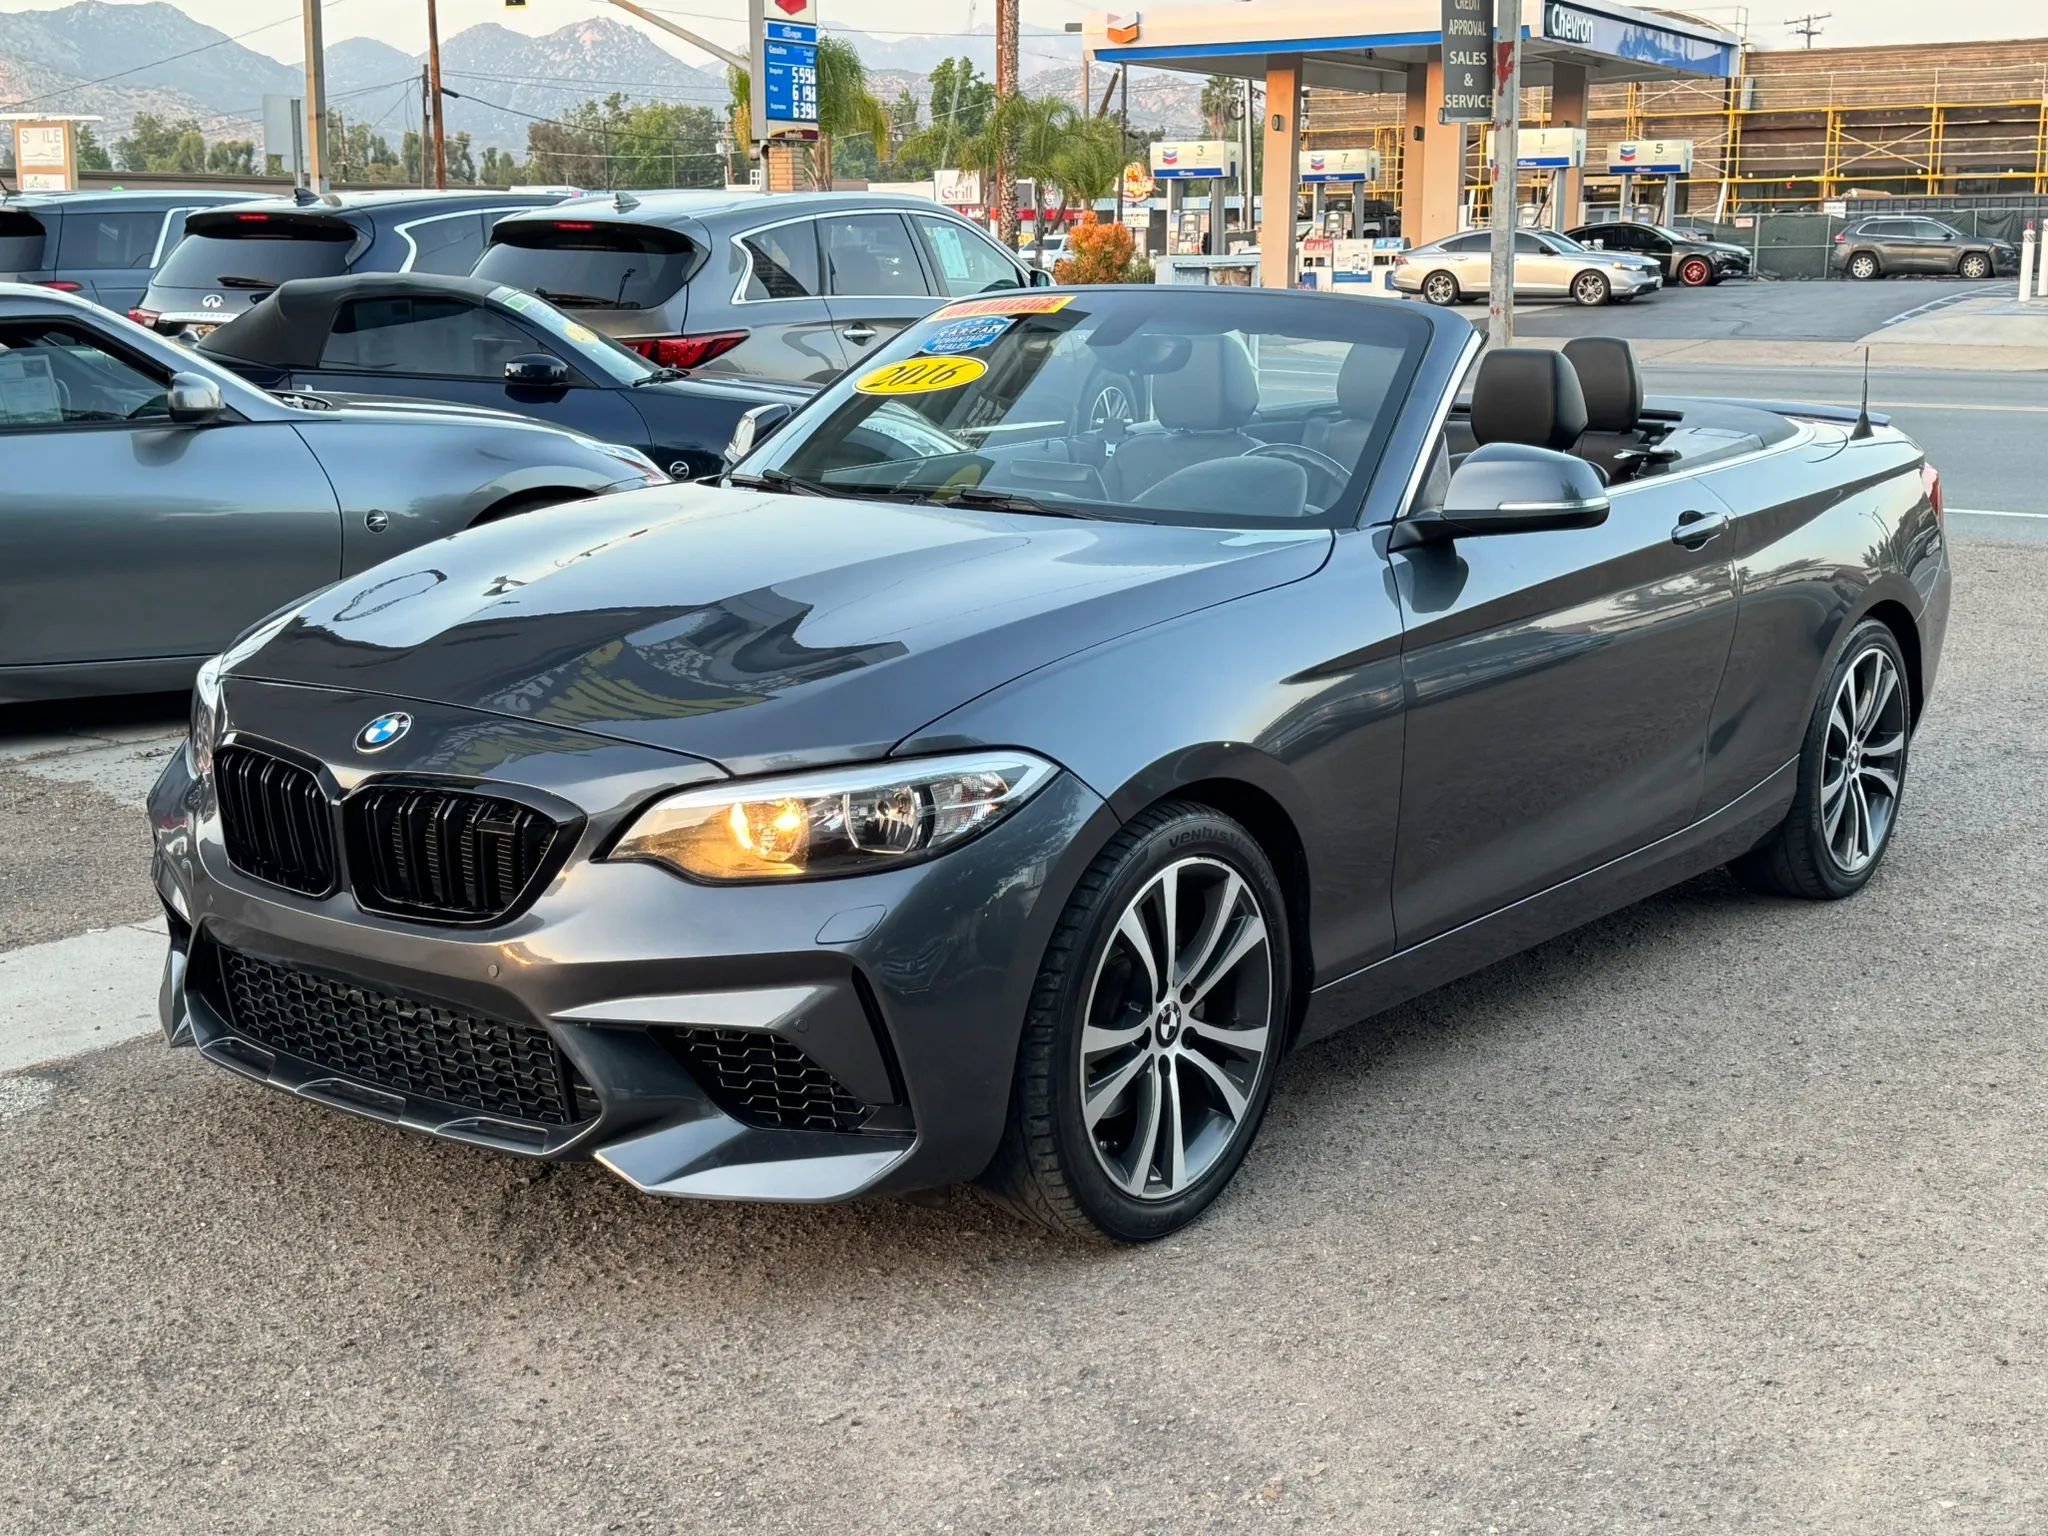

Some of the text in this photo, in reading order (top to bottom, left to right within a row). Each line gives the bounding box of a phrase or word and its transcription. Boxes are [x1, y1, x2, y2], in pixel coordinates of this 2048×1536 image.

[1449, 19, 1487, 36] APPROVAL
[1551, 4, 1594, 43] Chevron
[1450, 51, 1487, 66] SALES
[1464, 73, 1474, 87] &
[1445, 95, 1492, 109] SERVICE
[1196, 145, 1205, 156] 3
[1655, 143, 1664, 154] 5
[1341, 153, 1349, 163] 7
[941, 184, 973, 200] Grill
[866, 362, 976, 389] 2016
